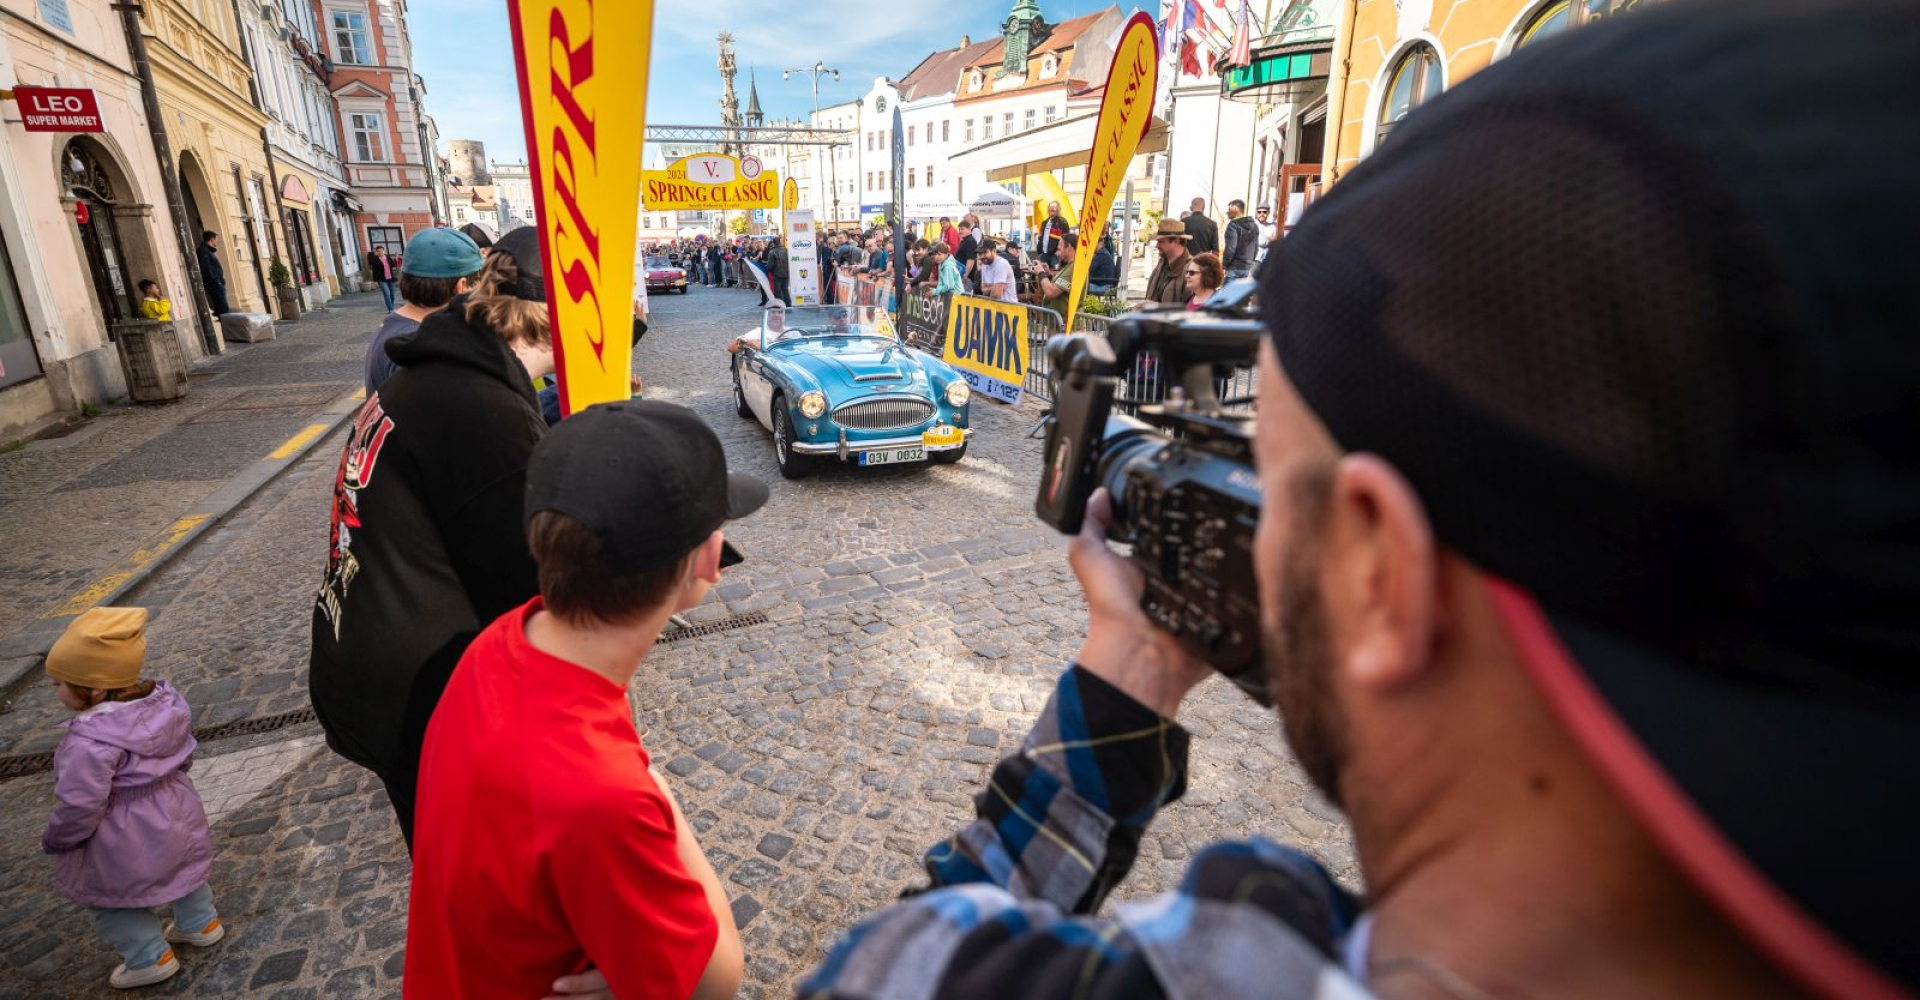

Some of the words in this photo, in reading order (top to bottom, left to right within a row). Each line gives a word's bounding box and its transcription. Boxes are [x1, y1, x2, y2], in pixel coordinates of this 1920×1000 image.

[32, 95, 83, 112] LEO
[26, 115, 59, 126] SUPER
[60, 115, 97, 126] MARKET
[1080, 162, 1109, 257] SPRING
[1108, 37, 1149, 165] CLASSIC
[667, 170, 687, 180] 2024
[648, 179, 707, 202] SPRING
[711, 179, 774, 202] CLASSIC
[953, 304, 1022, 376] UAMK
